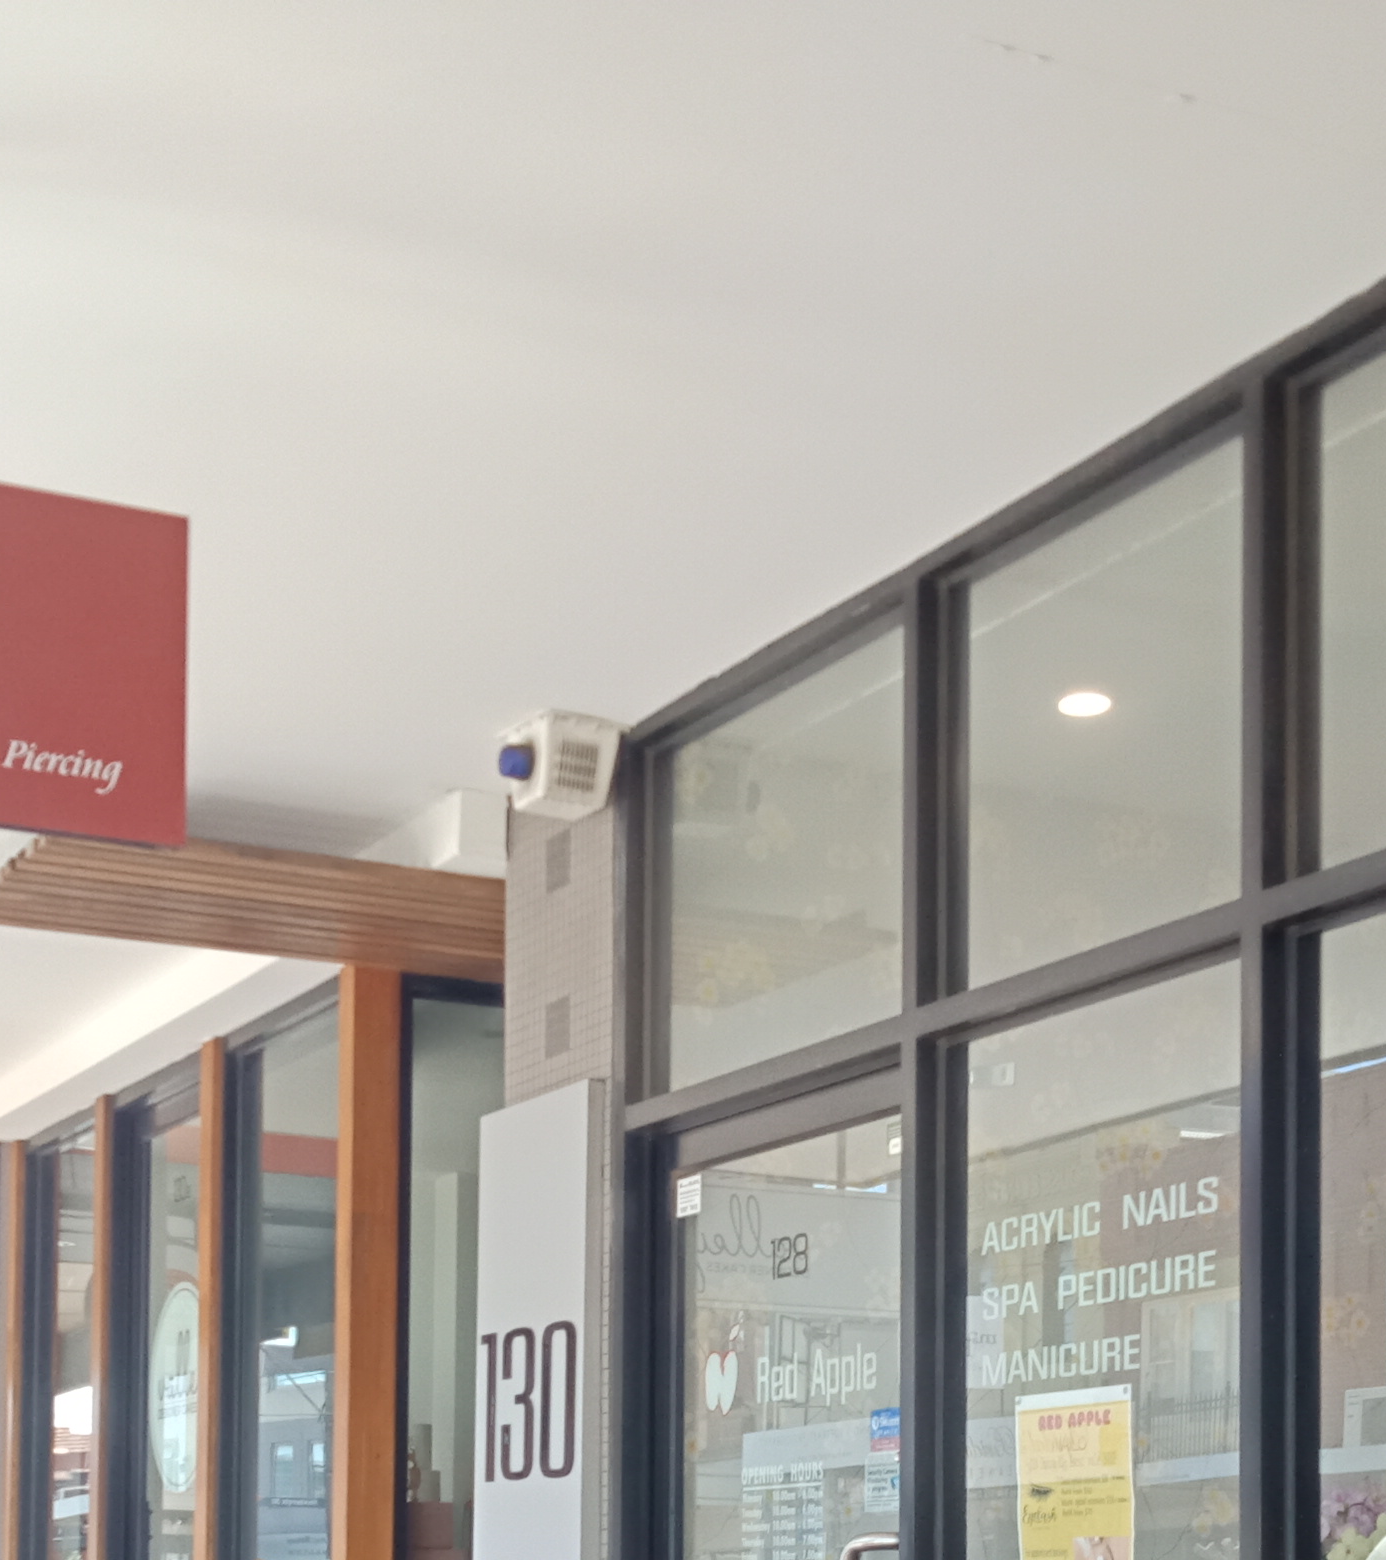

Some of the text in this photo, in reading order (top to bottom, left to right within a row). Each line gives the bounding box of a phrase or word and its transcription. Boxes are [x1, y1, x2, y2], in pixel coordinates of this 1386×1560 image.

[1, 739, 124, 795] Piercing
[981, 1176, 1219, 1256] ACRYLIC NAILS
[771, 1232, 809, 1280] 128
[982, 1249, 1217, 1321] SPA PEDICURE
[756, 1343, 877, 1406] Red Apple
[981, 1334, 1141, 1387] MANICURE
[481, 1320, 576, 1482] 130
[1038, 1409, 1111, 1431] RED APPLE
[741, 1461, 824, 1485] OPENING HOURS
